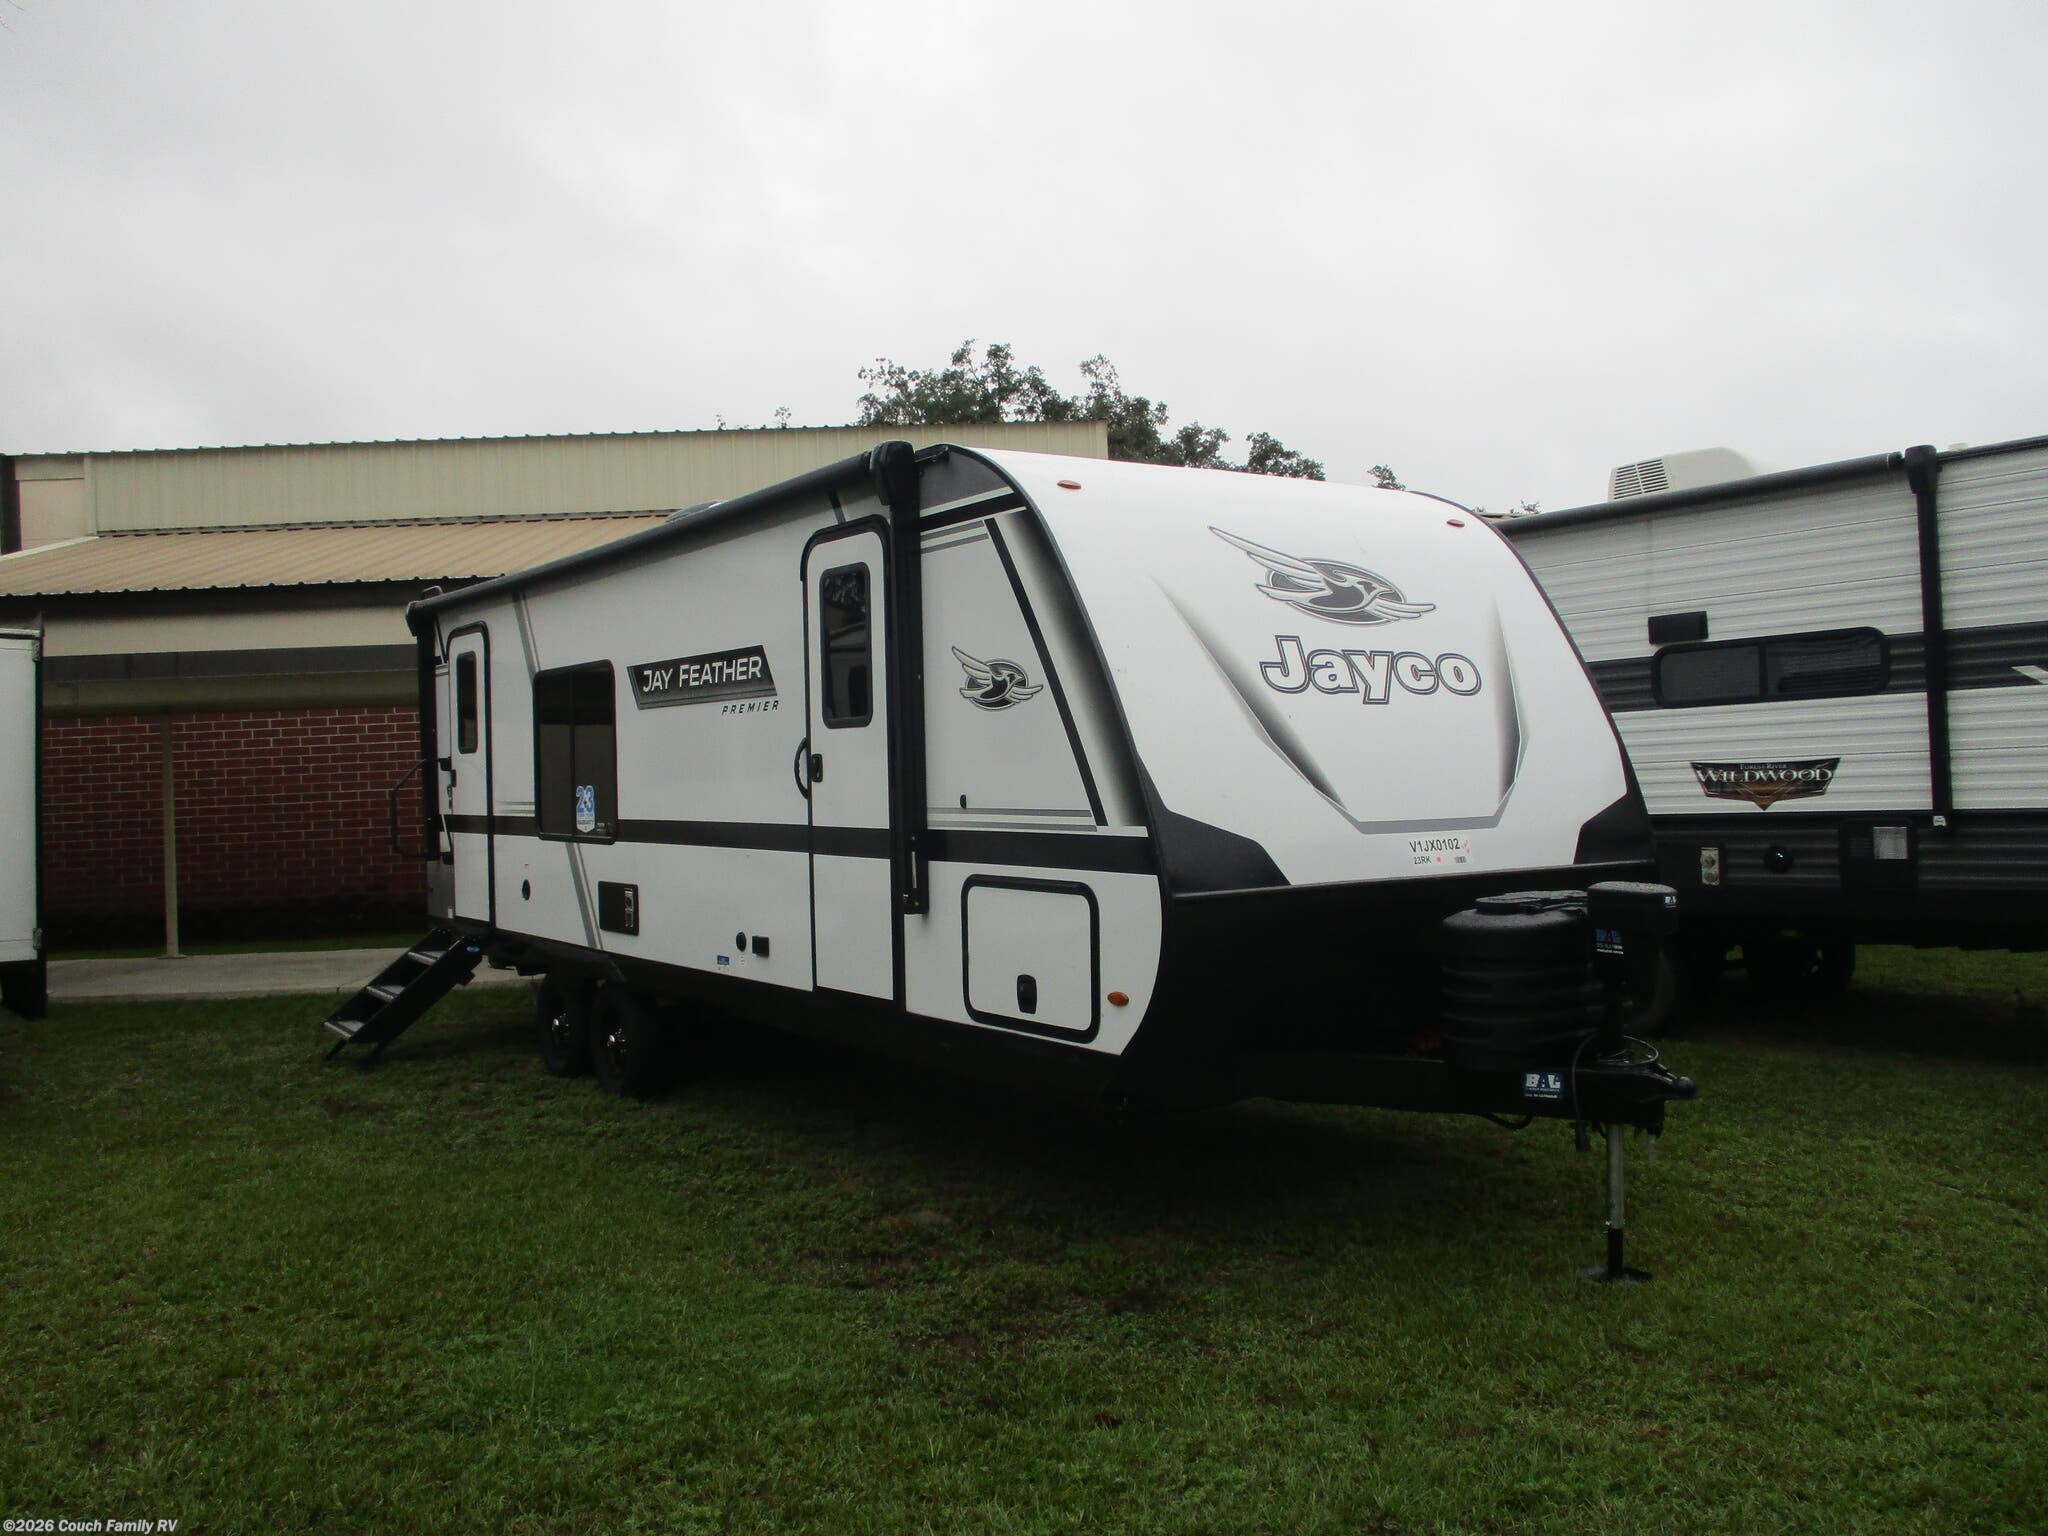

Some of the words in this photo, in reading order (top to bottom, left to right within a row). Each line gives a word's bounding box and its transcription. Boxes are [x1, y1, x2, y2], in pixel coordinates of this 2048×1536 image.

[642, 667, 673, 693] JAY
[679, 656, 762, 688] FEATHER
[1259, 634, 1482, 705] Jayco
[721, 700, 780, 715] PREMIER
[1696, 768, 1833, 783] WILDWOOD
[1409, 838, 1461, 853] V1JX0102
